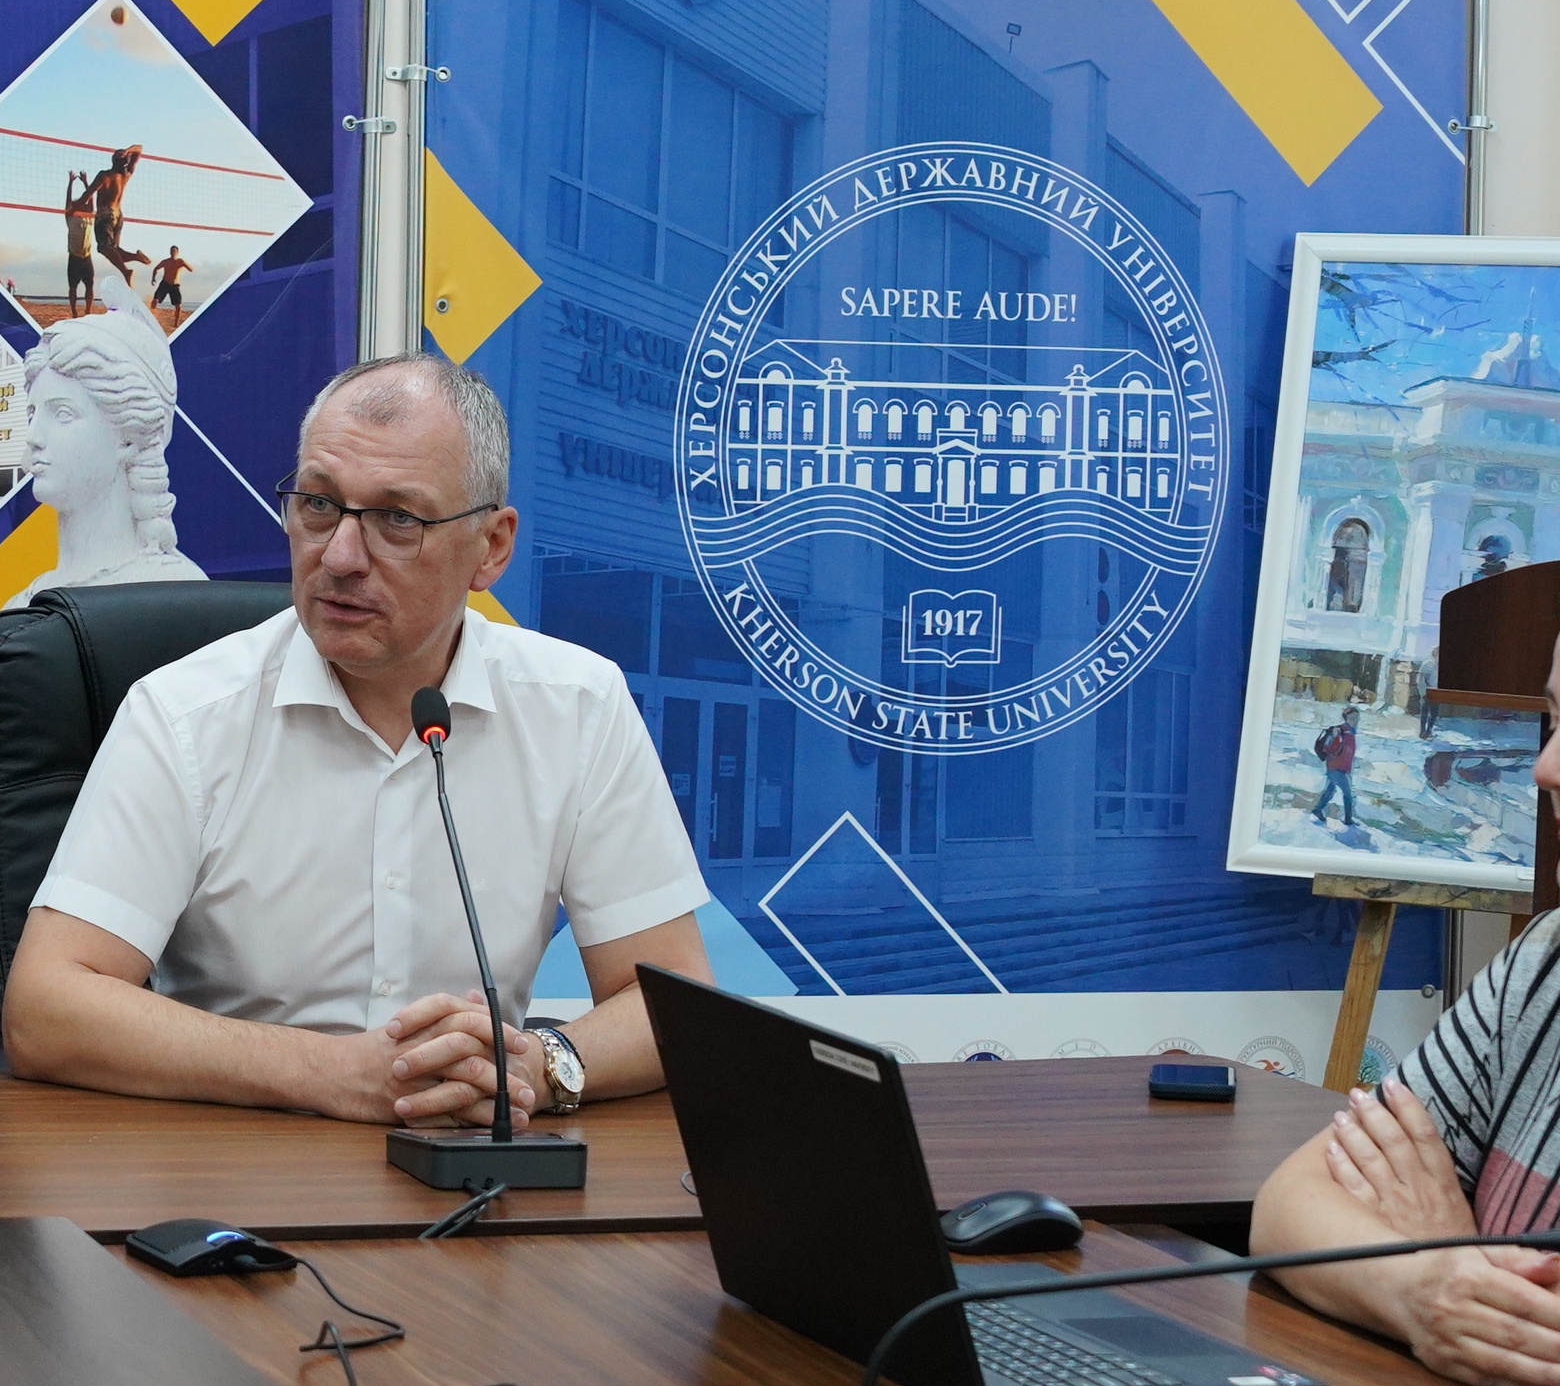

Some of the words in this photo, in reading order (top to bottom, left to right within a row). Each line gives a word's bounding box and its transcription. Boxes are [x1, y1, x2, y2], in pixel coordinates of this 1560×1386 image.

[690, 195, 842, 491] ХЕРСОНСЬКИЙ
[852, 157, 1099, 233] ДЕРЖАВНИЙ
[1105, 221, 1217, 503] УНІВЕРСИТЕТ
[840, 286, 963, 321] SAPERE
[973, 292, 1079, 324] AUDE!
[723, 581, 868, 720] KHERSON
[872, 704, 974, 741] STATE
[986, 588, 1174, 737] UNIVERSITY
[921, 607, 984, 639] 1917
